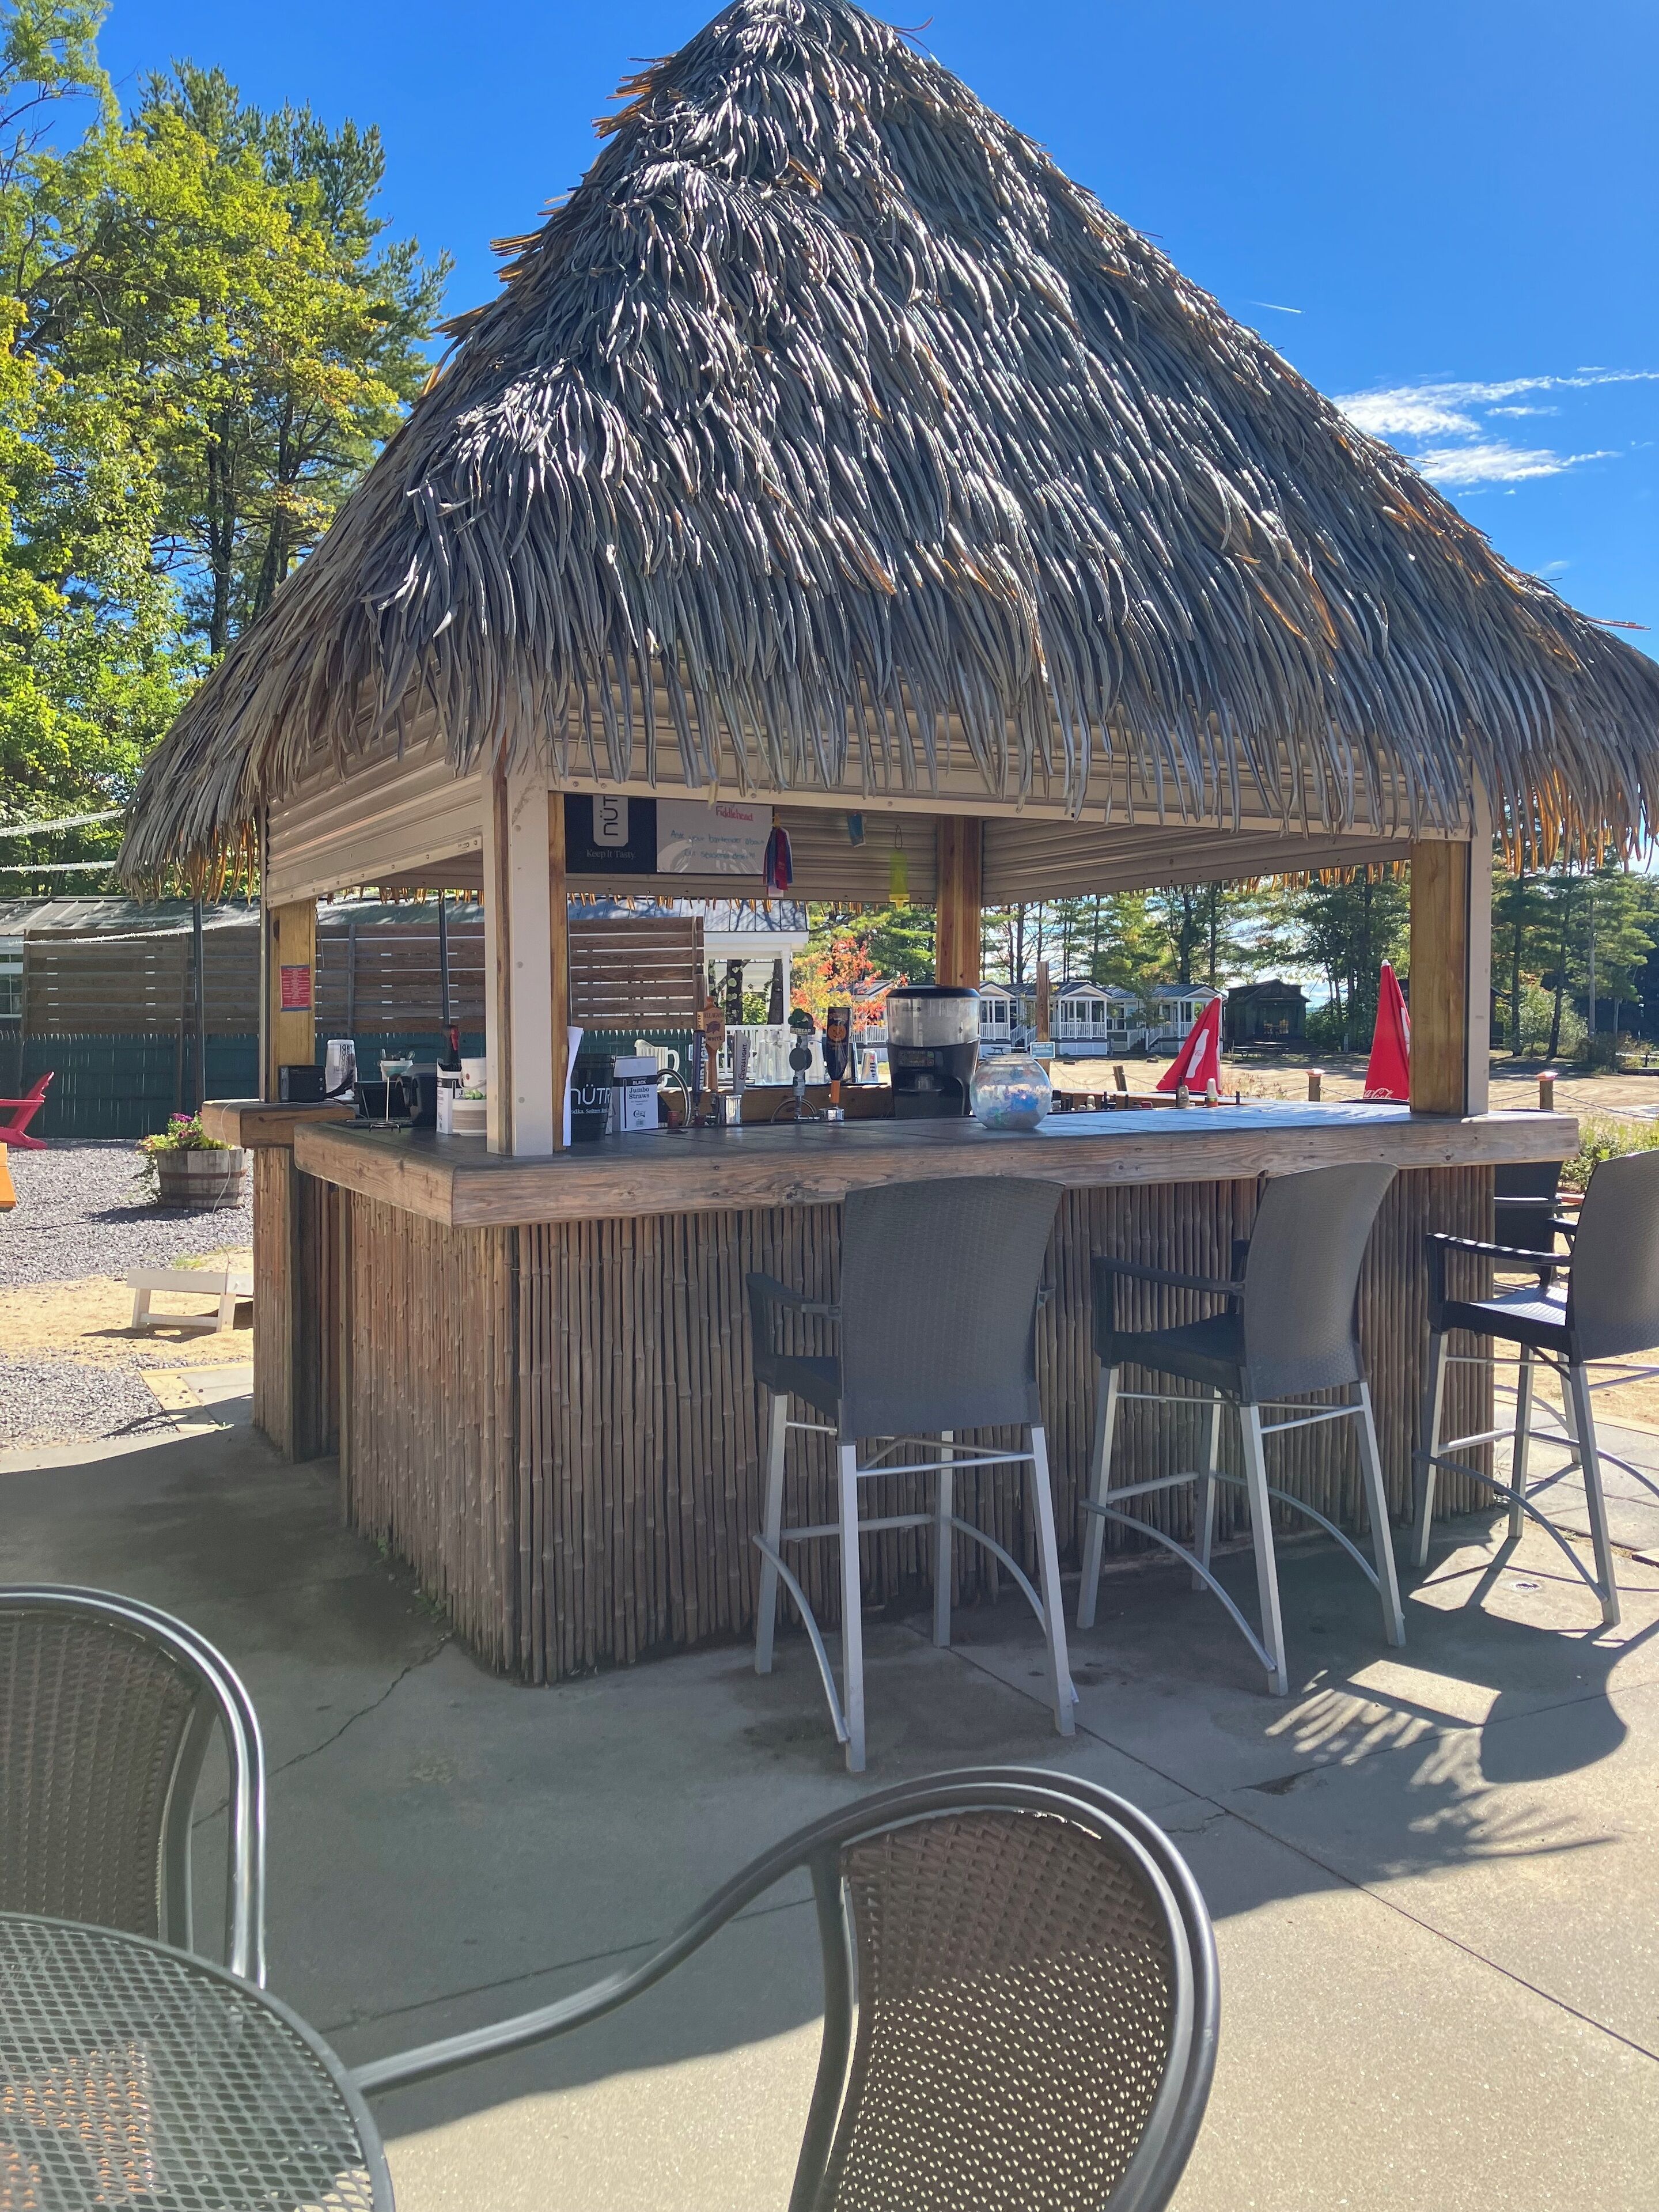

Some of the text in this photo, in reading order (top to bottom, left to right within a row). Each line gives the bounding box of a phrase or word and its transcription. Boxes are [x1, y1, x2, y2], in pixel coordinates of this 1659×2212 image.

[716, 806, 753, 821] Fiddlehead
[586, 850, 635, 859] Keep It Tasty
[738, 1060, 747, 1081] Coors
